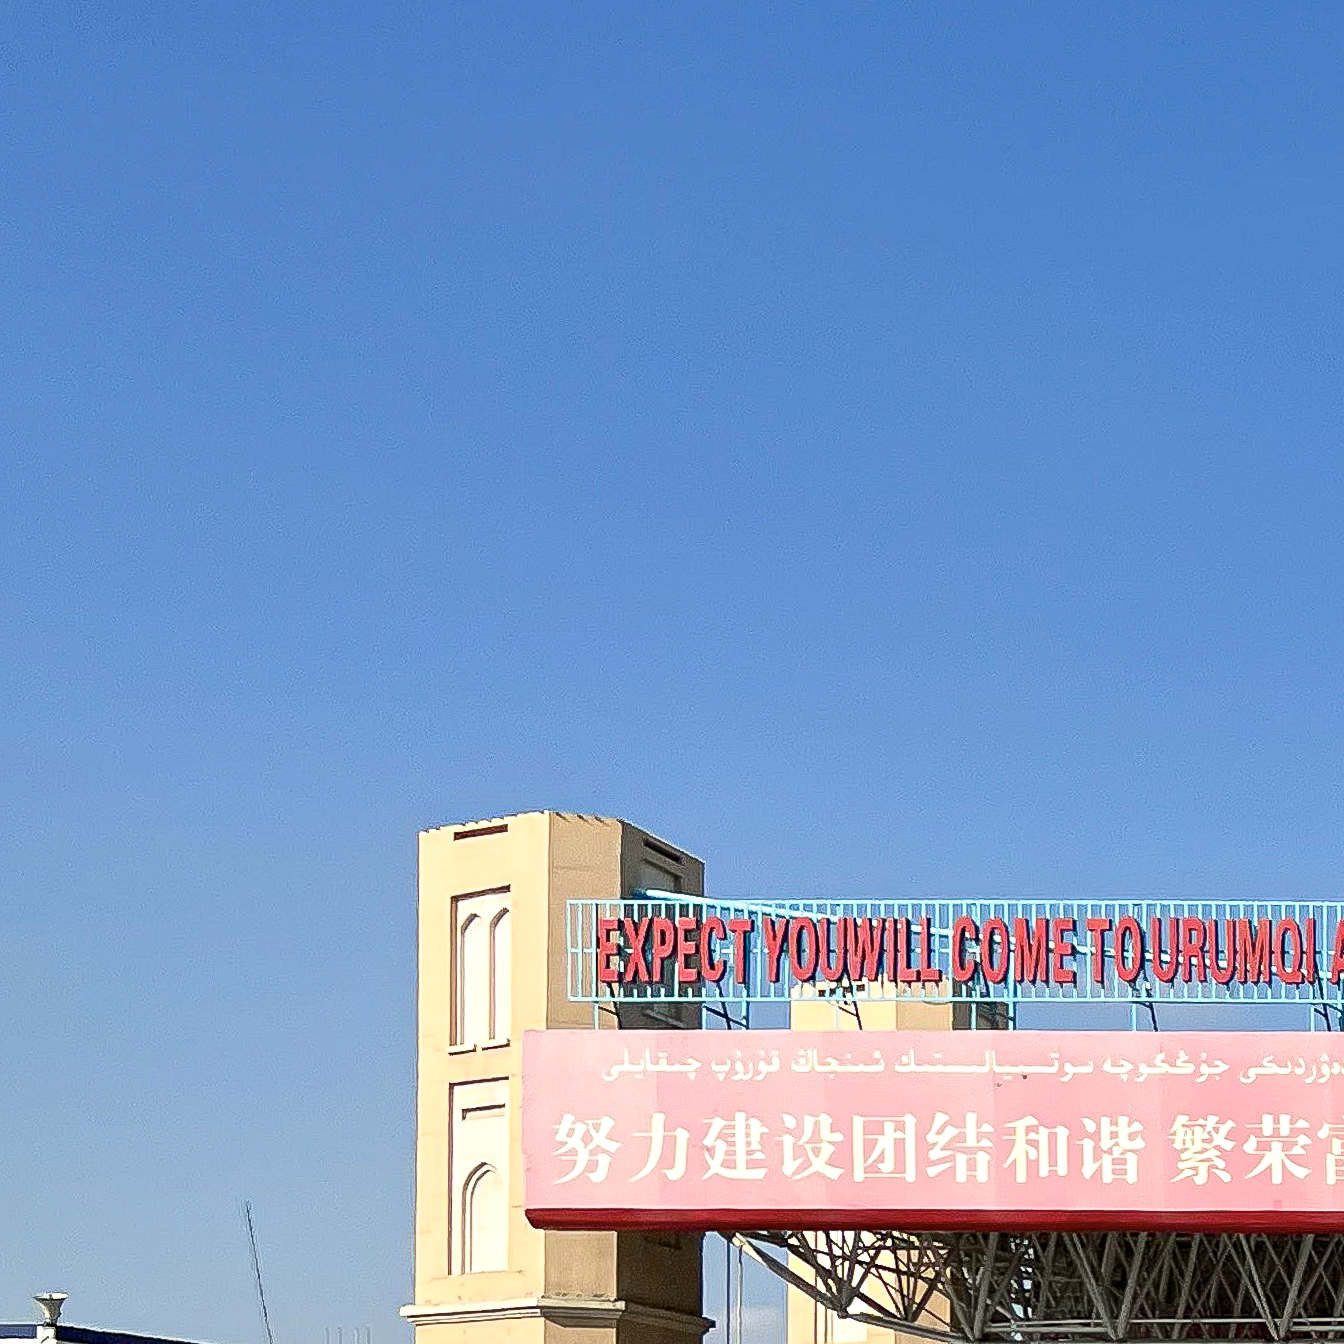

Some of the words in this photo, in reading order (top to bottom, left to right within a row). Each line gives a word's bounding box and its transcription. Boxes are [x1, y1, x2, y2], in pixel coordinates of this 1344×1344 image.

[595, 916, 753, 984] EXPECT
[953, 916, 1076, 985] COME
[1151, 918, 1317, 986] URUMQI
[553, 1111, 1147, 1185] 努力建设团结和谐
